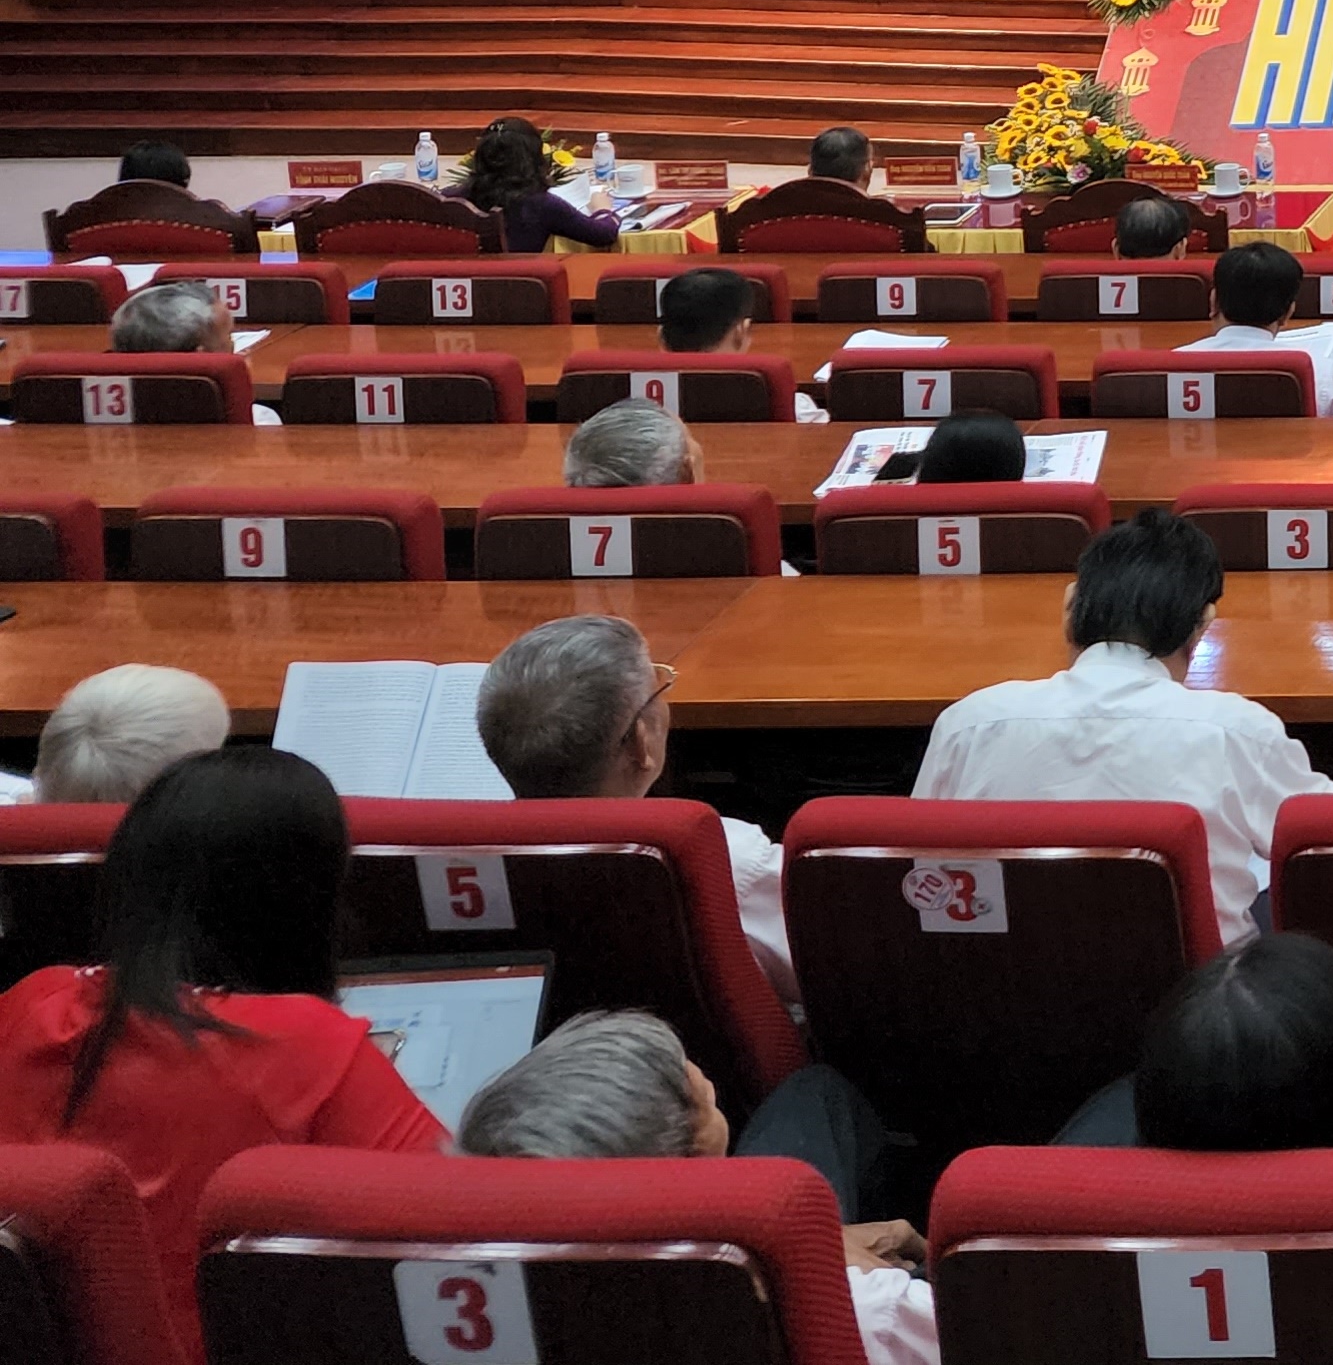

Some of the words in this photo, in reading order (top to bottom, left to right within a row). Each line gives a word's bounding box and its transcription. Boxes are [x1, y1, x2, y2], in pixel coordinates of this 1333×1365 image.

[435, 285, 467, 310] 13
[889, 283, 904, 309] 9
[1113, 282, 1126, 307] 7
[88, 384, 125, 416] 13
[361, 384, 396, 415] 11
[645, 379, 664, 410] 9
[918, 378, 936, 409] 7
[1182, 380, 1202, 411] 5
[240, 527, 263, 567] 9
[588, 525, 612, 566] 7
[937, 526, 961, 567] 5
[1286, 518, 1309, 559] 3
[445, 867, 485, 919] 5
[914, 873, 944, 903] 170
[945, 869, 977, 922] 3
[437, 1277, 494, 1351] 3
[1189, 1269, 1229, 1342] 1
